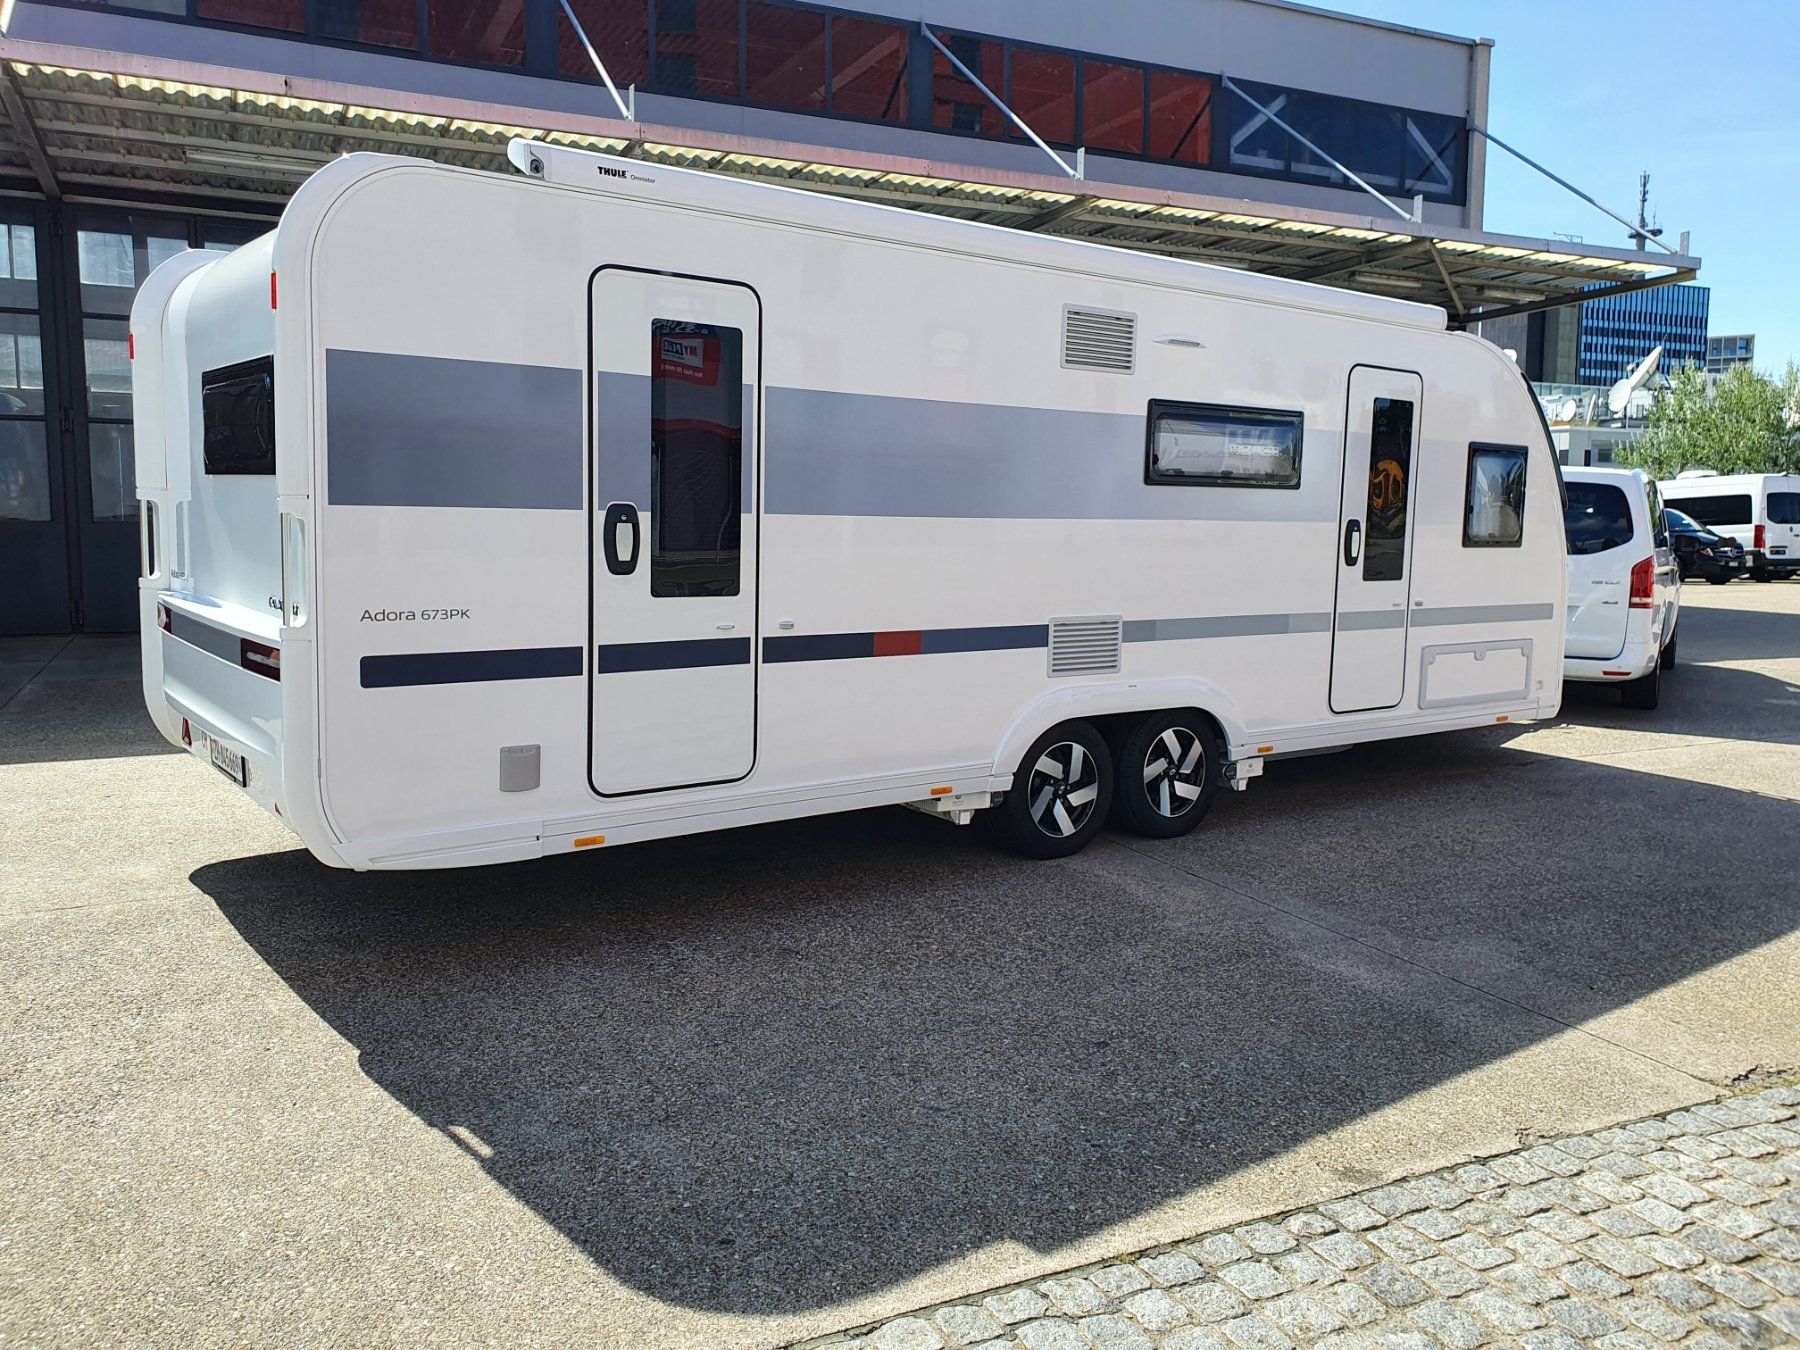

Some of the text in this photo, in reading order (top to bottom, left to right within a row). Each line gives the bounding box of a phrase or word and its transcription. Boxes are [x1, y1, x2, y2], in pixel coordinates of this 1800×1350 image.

[598, 166, 656, 184] THULE Omnistor
[360, 608, 471, 622] Adora 673PK
